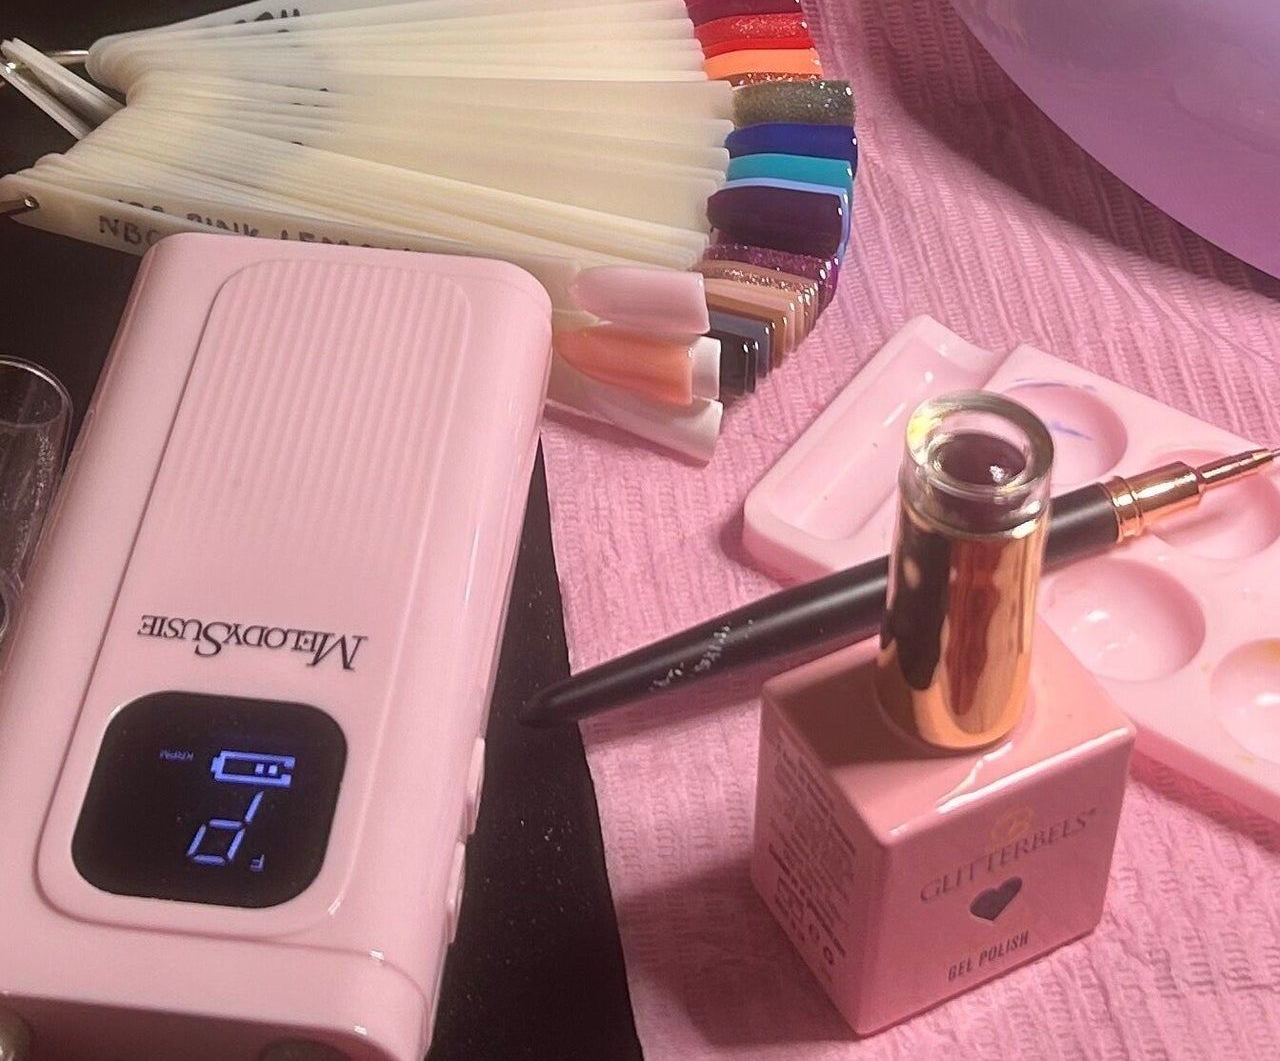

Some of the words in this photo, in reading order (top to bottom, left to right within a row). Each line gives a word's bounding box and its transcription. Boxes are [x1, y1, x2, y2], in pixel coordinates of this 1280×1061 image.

[136, 614, 369, 672] MELODYSUSIE
[947, 959, 975, 982] GEL
[977, 929, 1030, 968] POLISH
